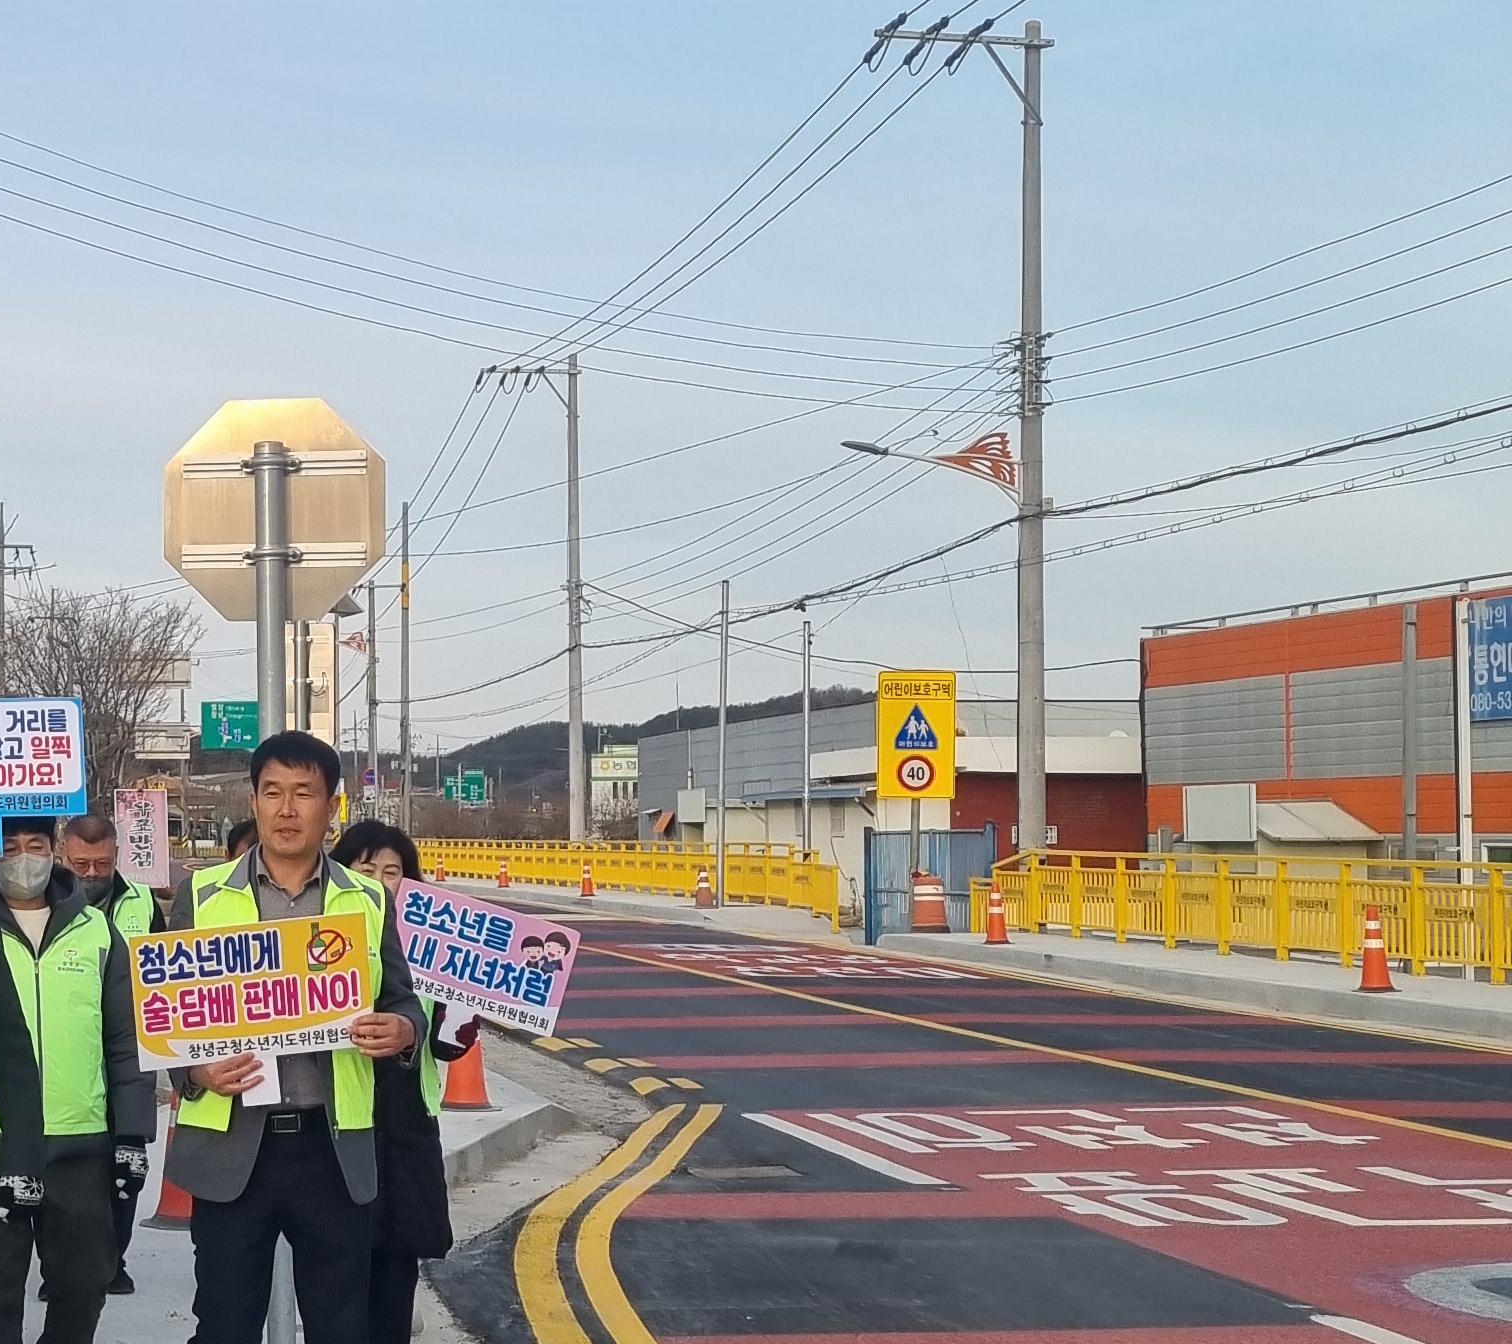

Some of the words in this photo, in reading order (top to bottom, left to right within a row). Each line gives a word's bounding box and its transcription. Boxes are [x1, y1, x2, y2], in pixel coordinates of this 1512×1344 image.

[884, 682, 950, 697] 어린이보호구역
[6, 709, 67, 733] 거리를
[31, 735, 72, 759] 일찍
[906, 766, 925, 781] 40
[403, 890, 514, 953] 청소년을
[138, 930, 281, 985] 청소년에게
[407, 933, 438, 970] 내
[440, 943, 555, 1008] 자녀처럼
[243, 976, 300, 1021] 판매
[307, 970, 360, 1012] NO!
[412, 976, 549, 1030] 창녕군청소년지도위원협의회
[188, 1027, 355, 1060] 창녕군청소년지도위원협의
